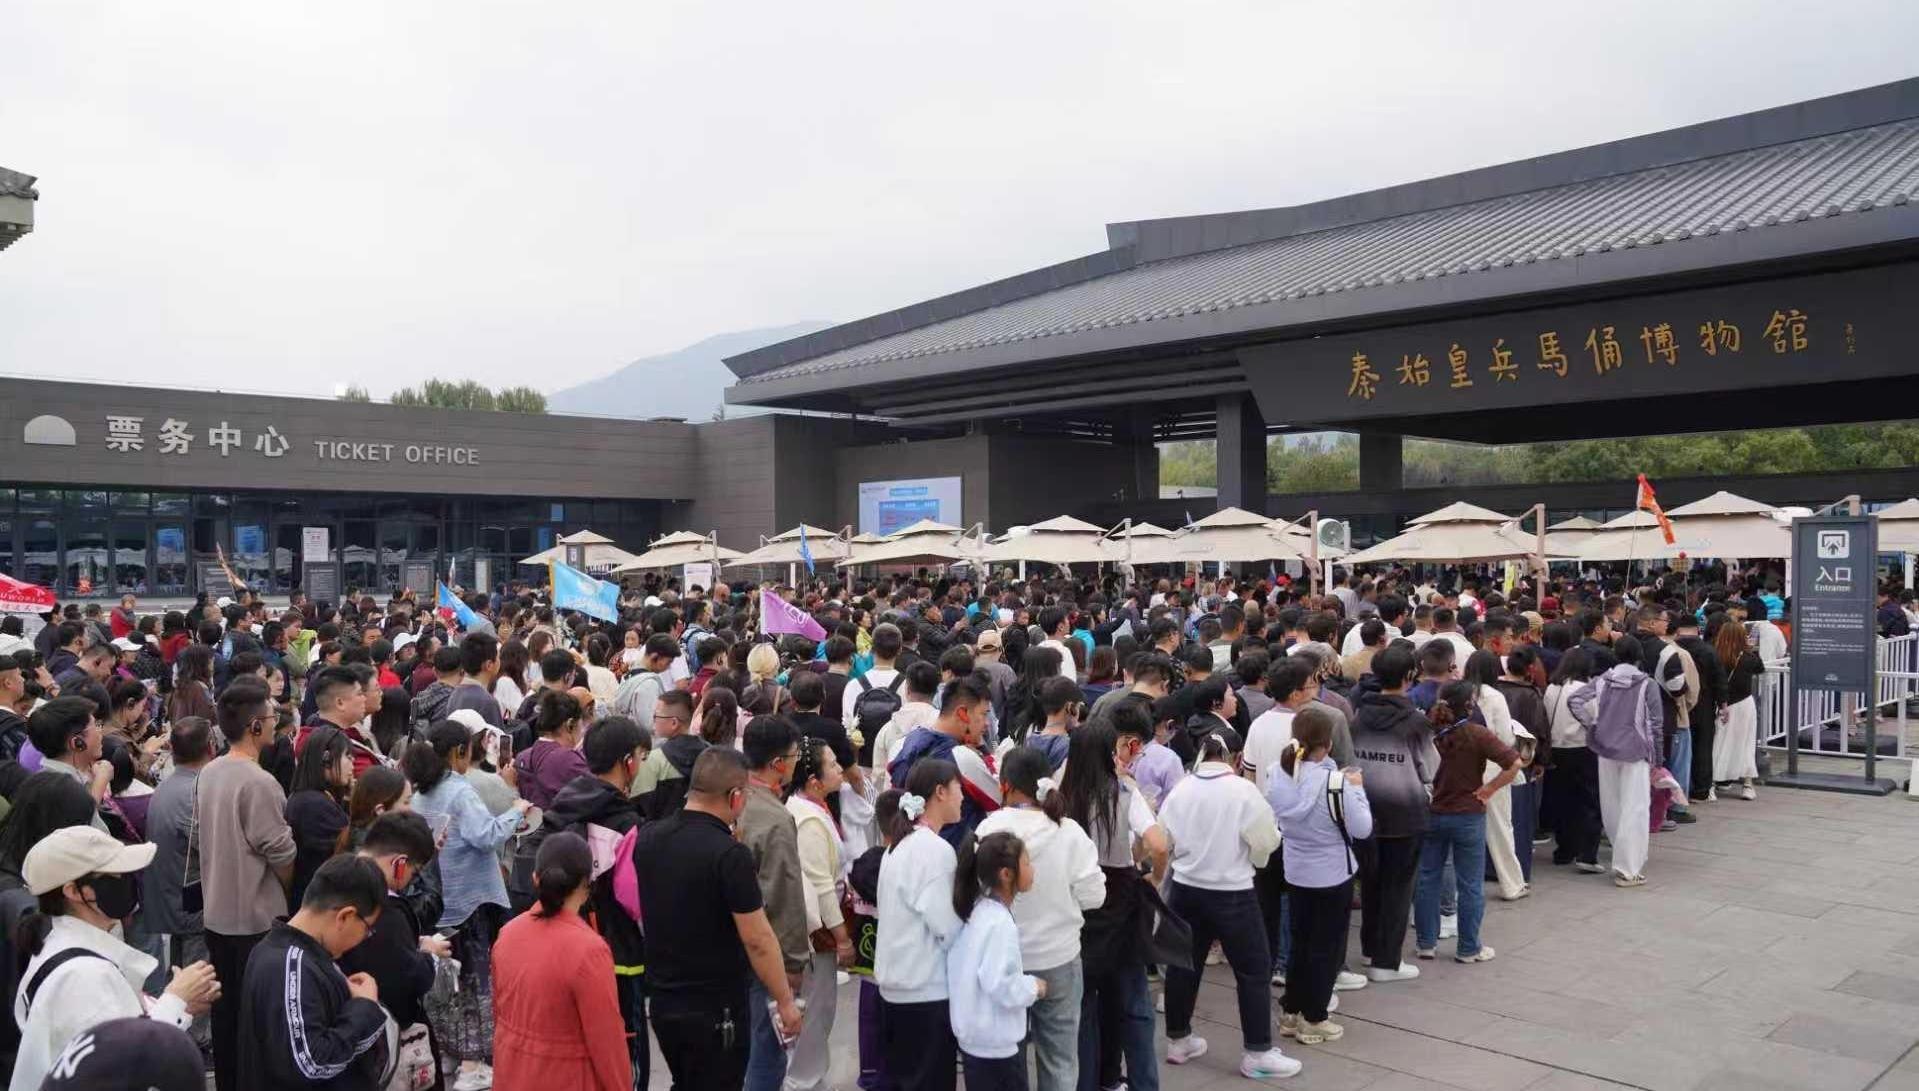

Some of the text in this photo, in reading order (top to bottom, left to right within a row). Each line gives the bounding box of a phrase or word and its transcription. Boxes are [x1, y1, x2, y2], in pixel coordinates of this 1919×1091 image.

[105, 415, 290, 457] 票务中心
[315, 440, 480, 465] TICKET OFFICE
[1816, 566, 1851, 582] 入口
